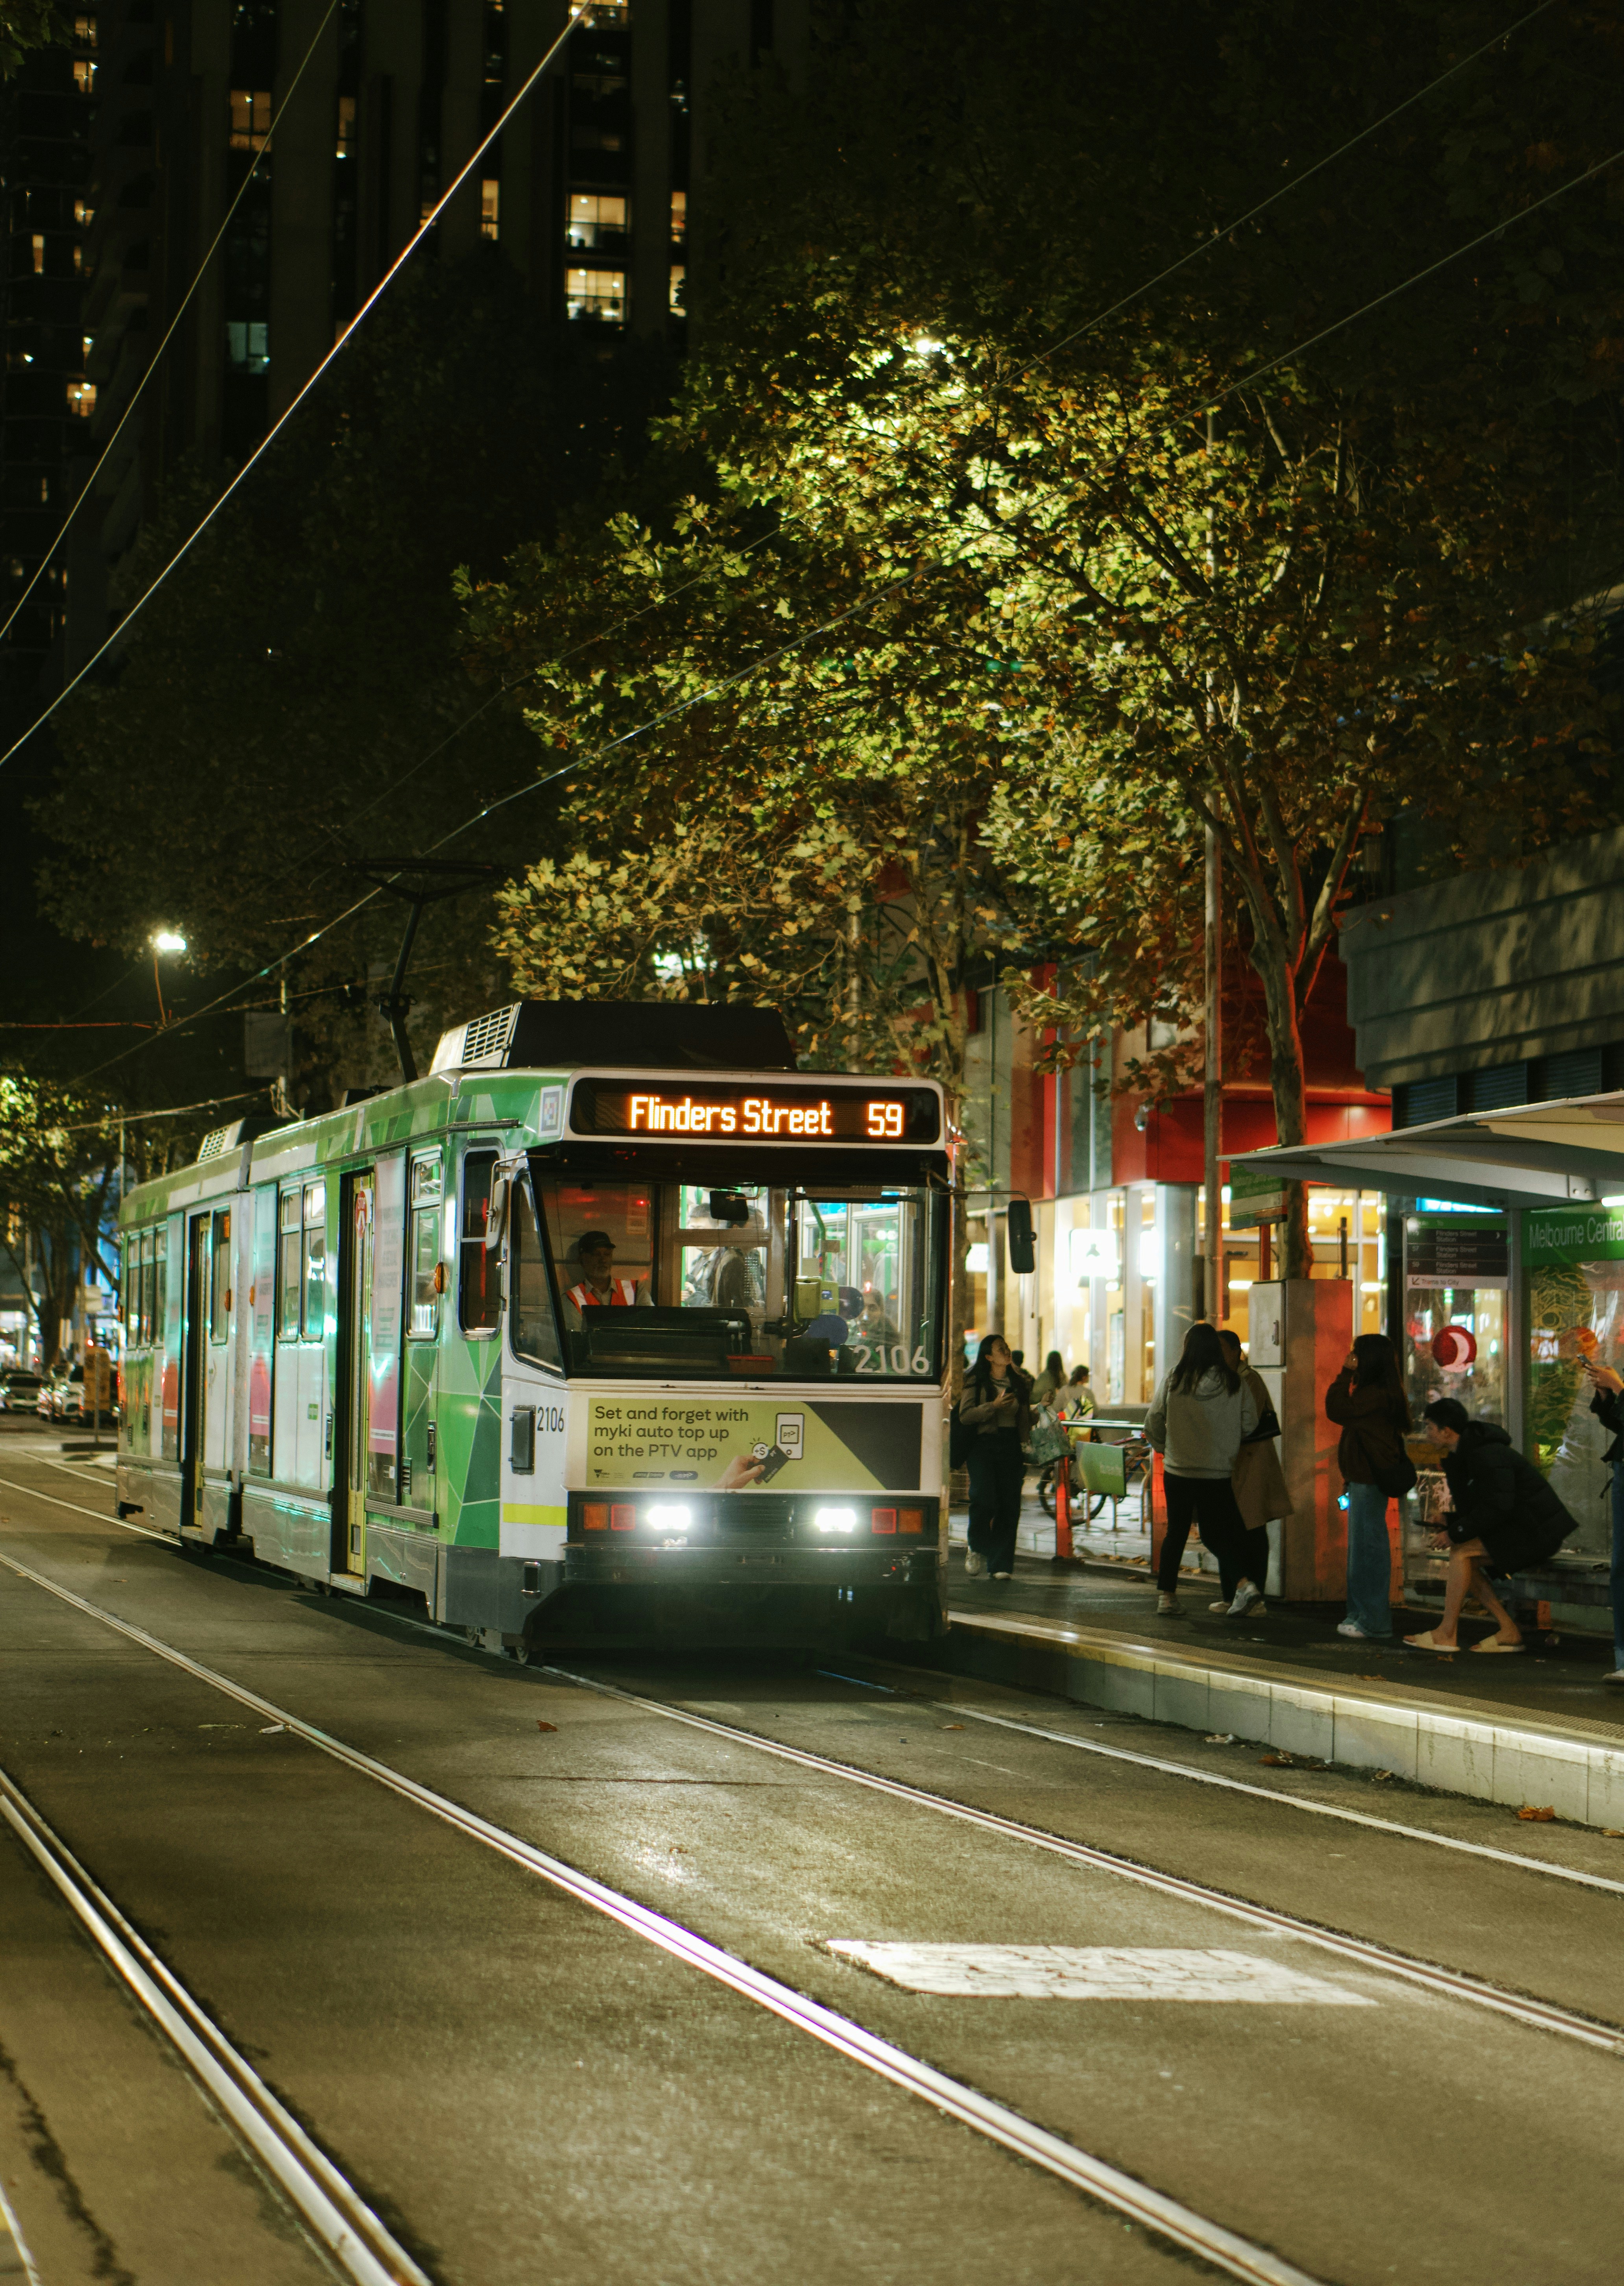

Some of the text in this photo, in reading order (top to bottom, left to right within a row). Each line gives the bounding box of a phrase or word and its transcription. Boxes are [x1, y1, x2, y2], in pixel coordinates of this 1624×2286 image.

[631, 1096, 902, 1136] Flinders Street 59
[1529, 1222, 1584, 1249] Melbourne
[853, 1344, 929, 1374] 2106
[537, 1406, 564, 1432] 2106
[594, 1406, 749, 1424] Set and forget with
[594, 1424, 729, 1441] myki auto top up
[594, 1444, 718, 1460] on the PTV app
